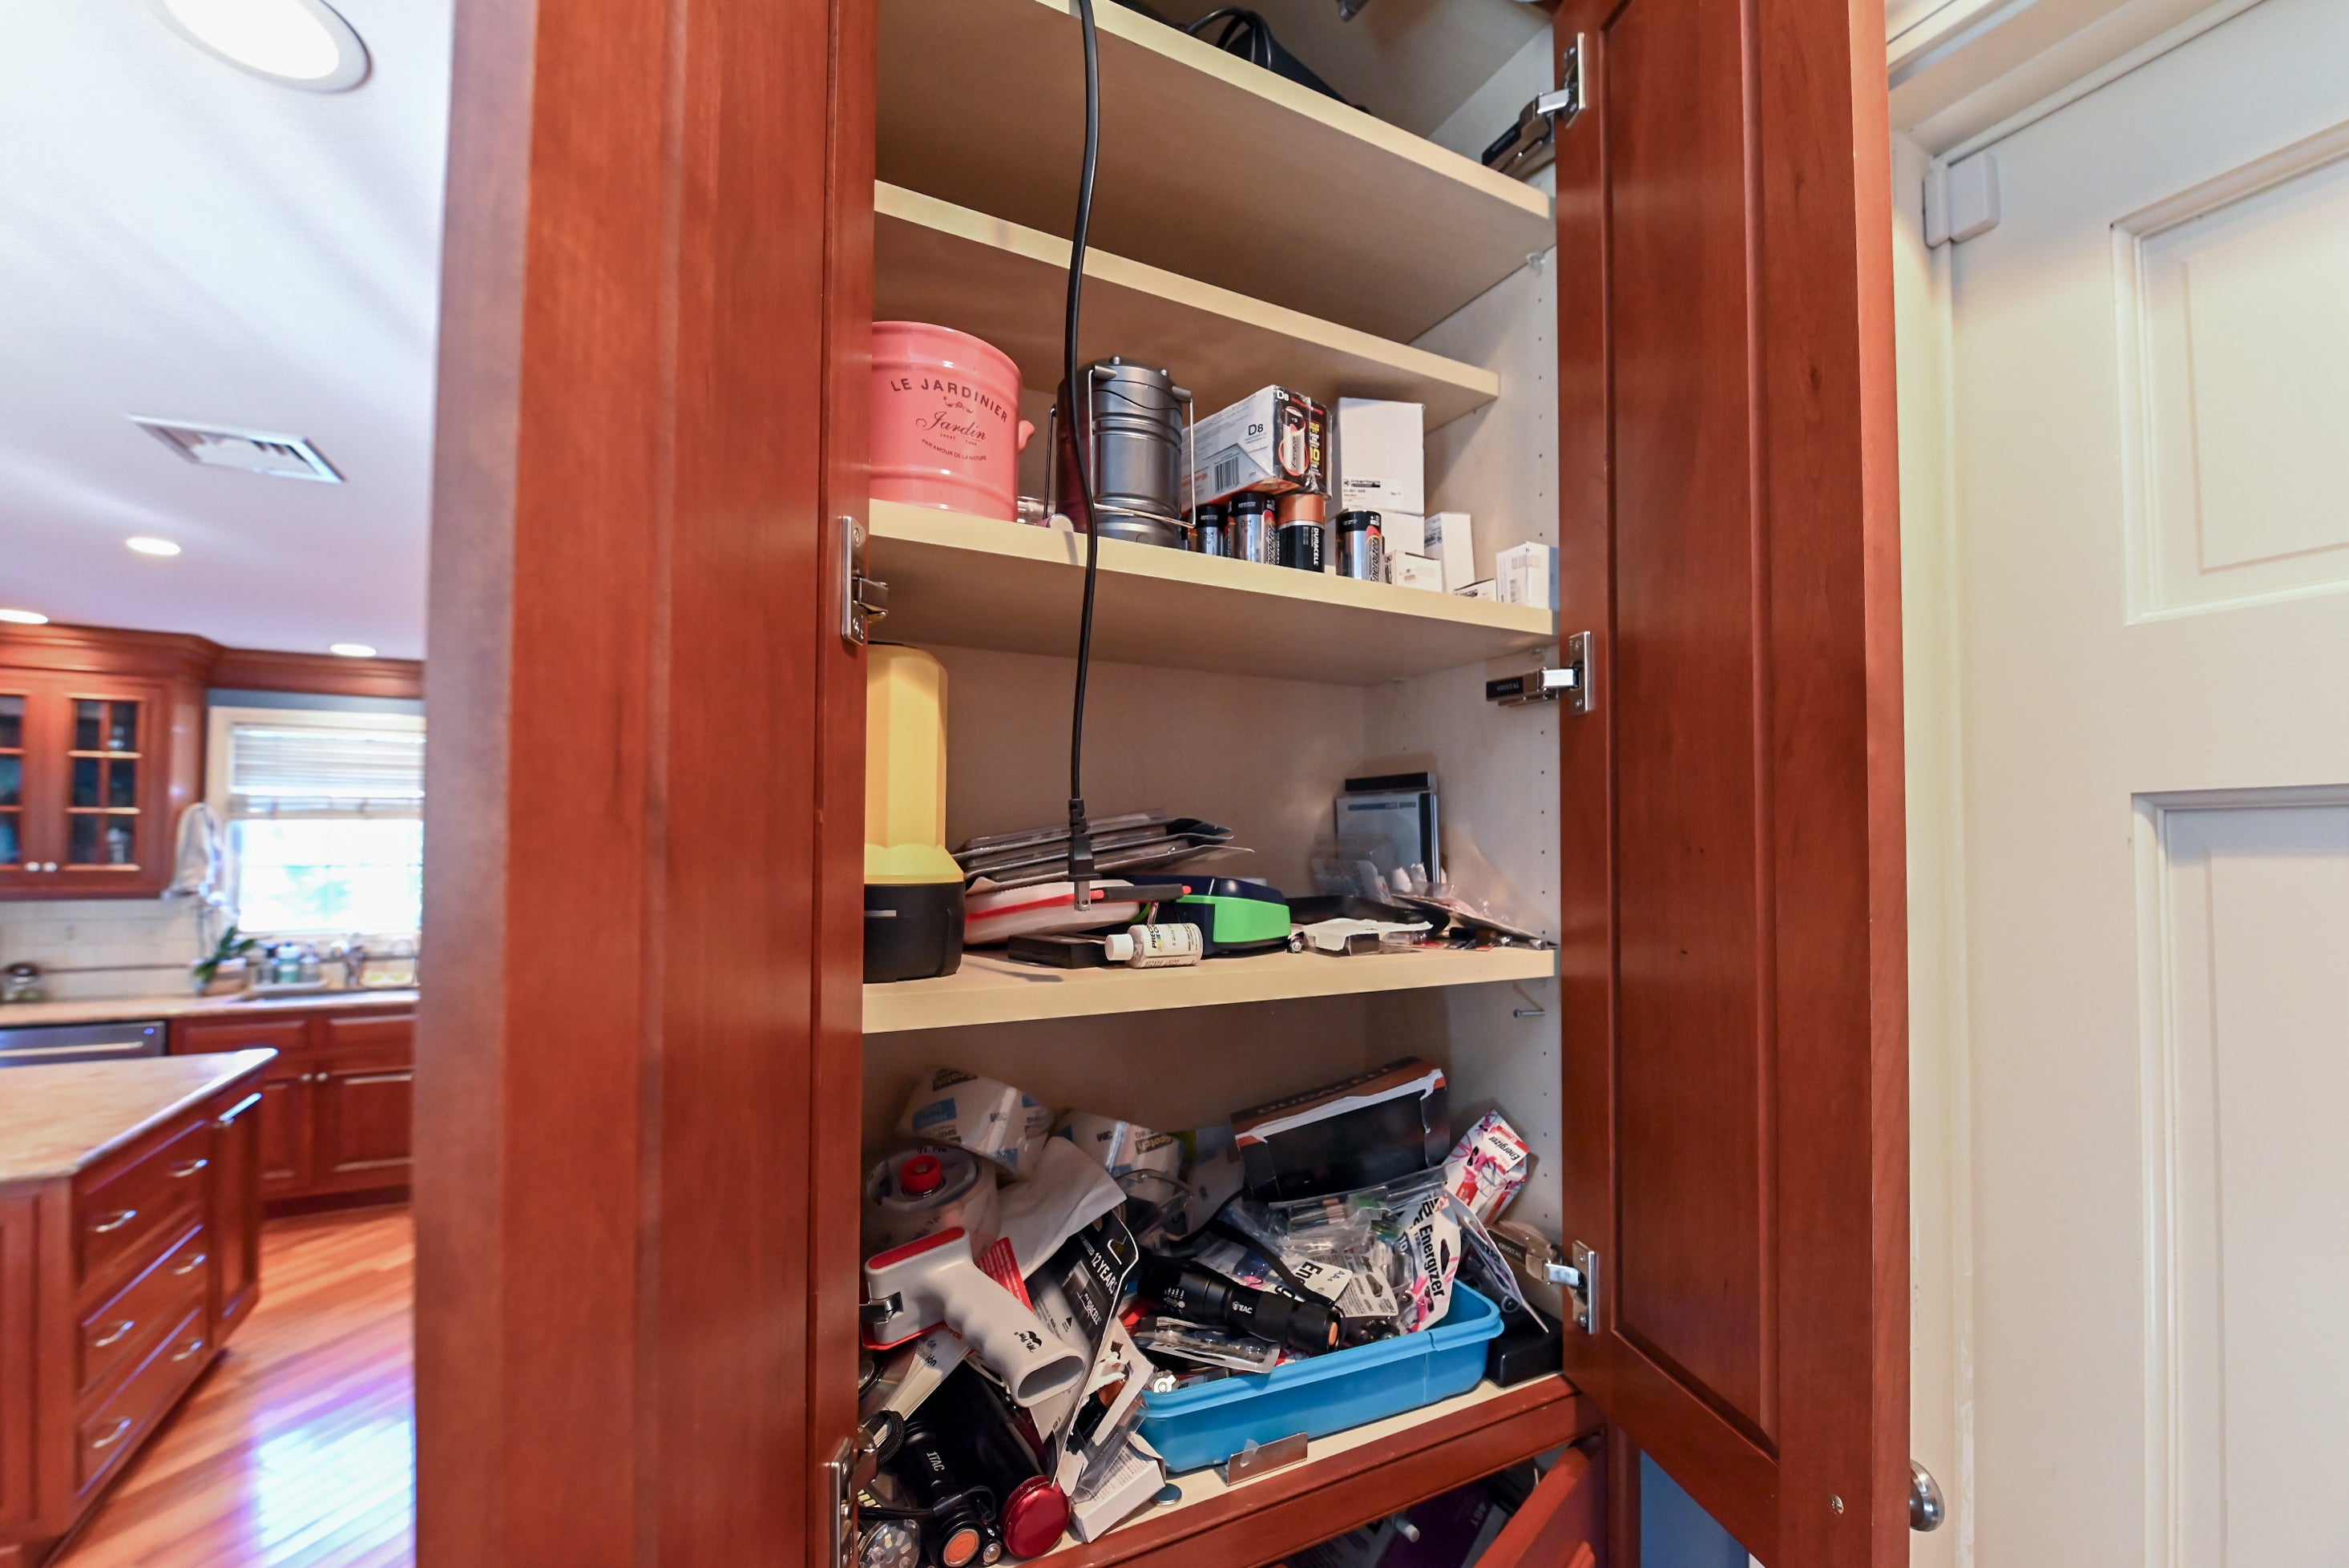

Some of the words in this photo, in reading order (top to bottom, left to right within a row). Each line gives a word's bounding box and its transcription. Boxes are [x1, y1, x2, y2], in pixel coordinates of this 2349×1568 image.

[890, 378, 913, 392] LE
[921, 378, 1008, 423] JARDINIER
[915, 410, 987, 441] Jardin
[1248, 423, 1264, 437] D8
[922, 438, 933, 449] PAR
[933, 445, 953, 456] AMOUR
[1096, 1131, 1113, 1143] 3M
[1138, 1135, 1171, 1152] Scotch
[1488, 1135, 1521, 1162] Energizer
[1399, 1235, 1408, 1252] 10
[1092, 1252, 1102, 1268] 12
[1419, 1223, 1445, 1297] Energizer
[1096, 1260, 1118, 1295] YEARS
